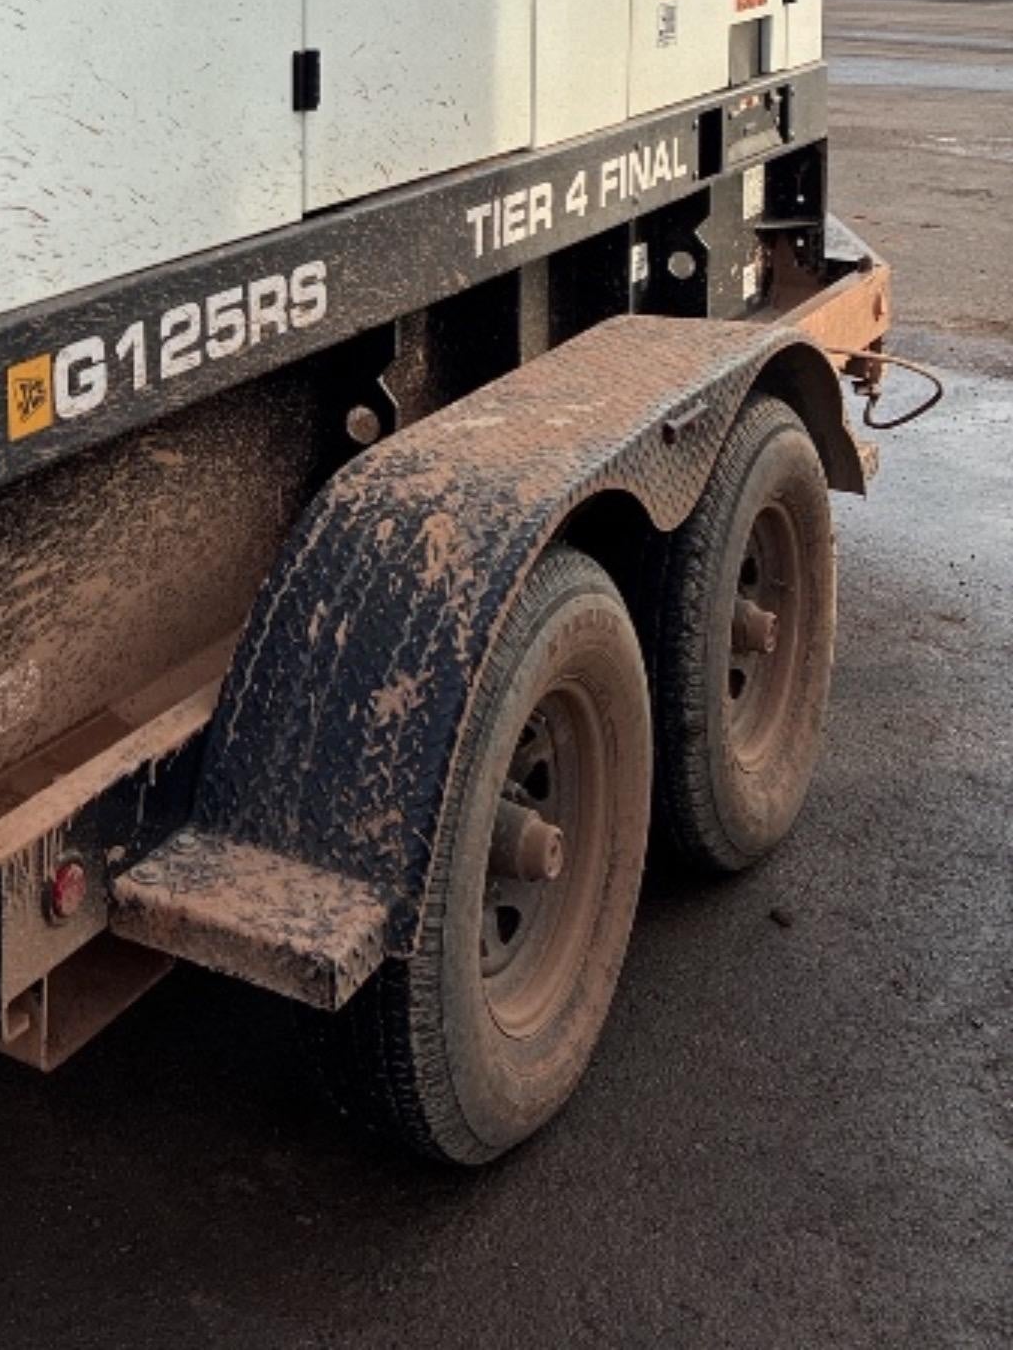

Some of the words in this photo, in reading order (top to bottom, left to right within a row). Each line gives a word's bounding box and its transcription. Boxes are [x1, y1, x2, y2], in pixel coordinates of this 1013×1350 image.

[466, 180, 553, 259] TIER
[564, 171, 588, 218] 4
[599, 136, 688, 210] FINAL
[53, 260, 327, 419] G125RS
